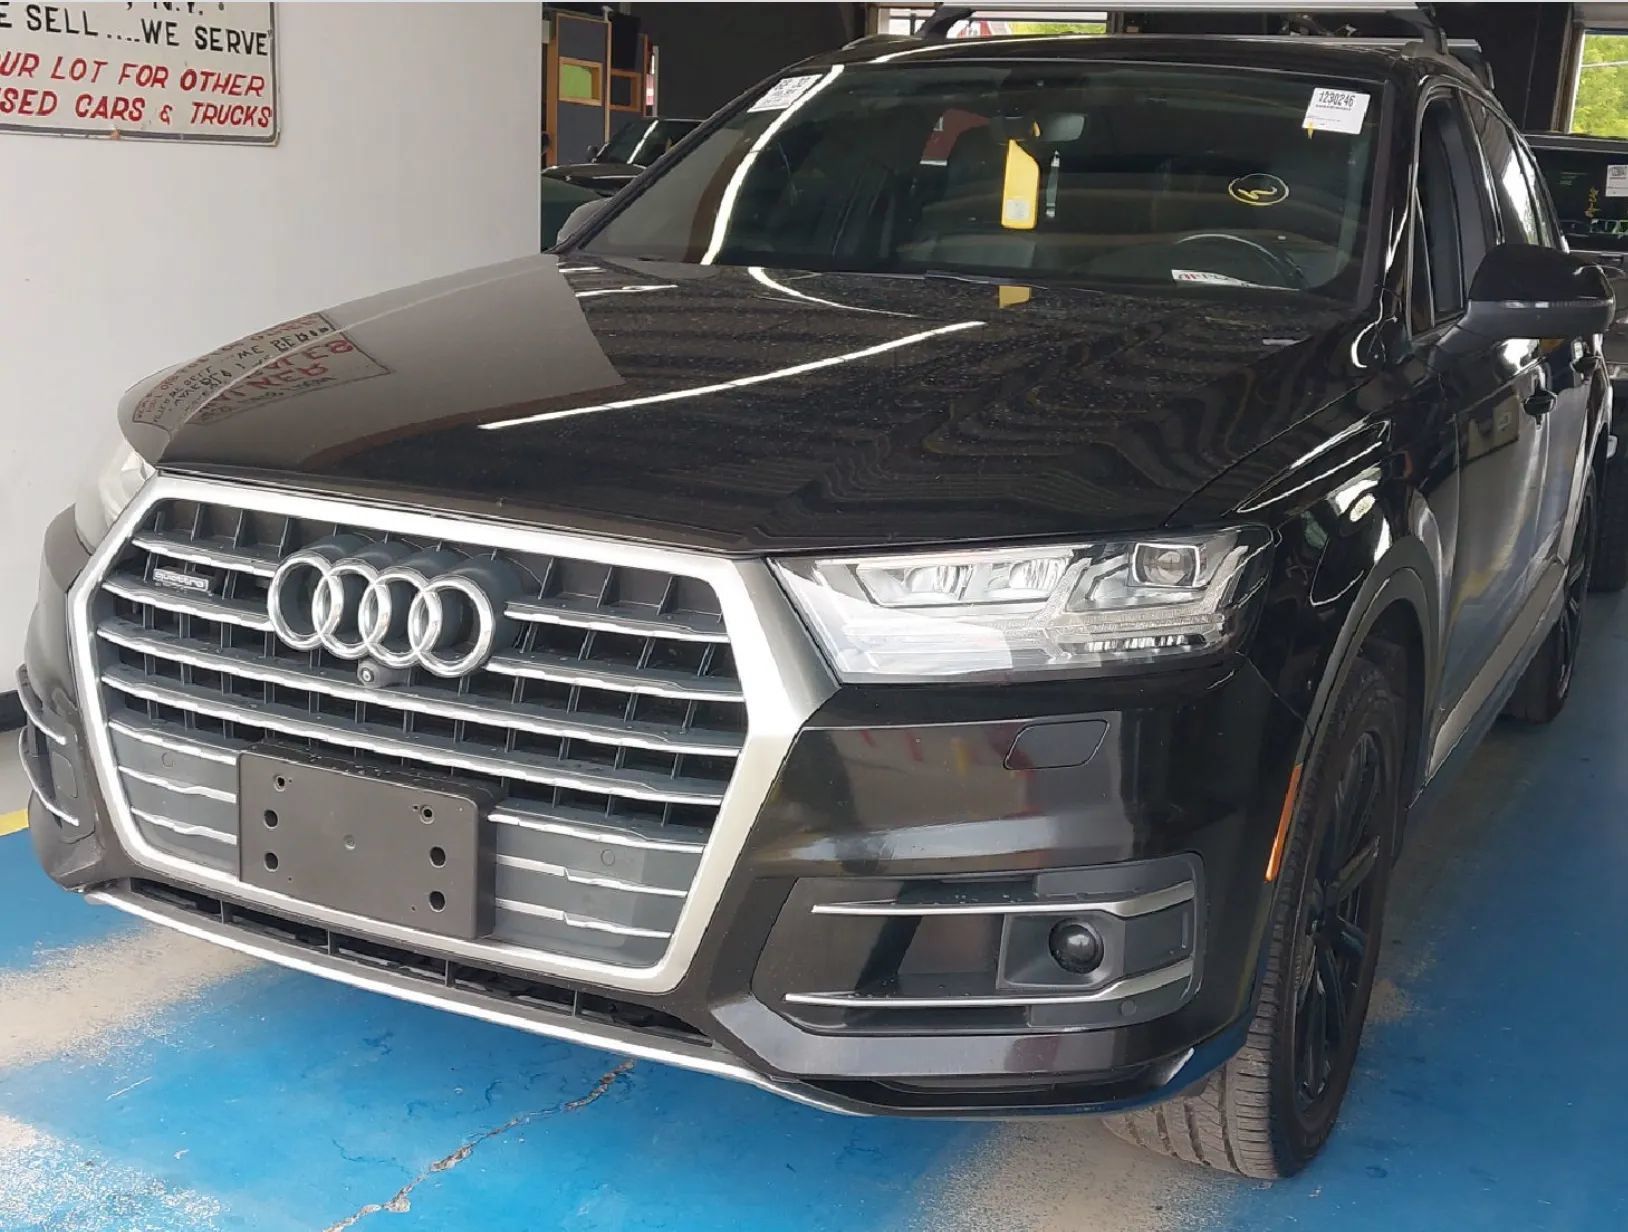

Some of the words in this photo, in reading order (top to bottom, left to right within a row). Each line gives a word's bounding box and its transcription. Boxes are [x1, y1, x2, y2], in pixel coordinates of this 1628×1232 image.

[194, 25, 268, 56] SERVE
[50, 56, 109, 83] LOT
[117, 63, 169, 89] FOR
[179, 68, 265, 97] OTHER
[0, 87, 58, 116] SED
[75, 93, 146, 122] CARS
[159, 104, 173, 125] &
[190, 101, 273, 129] TRUCKS
